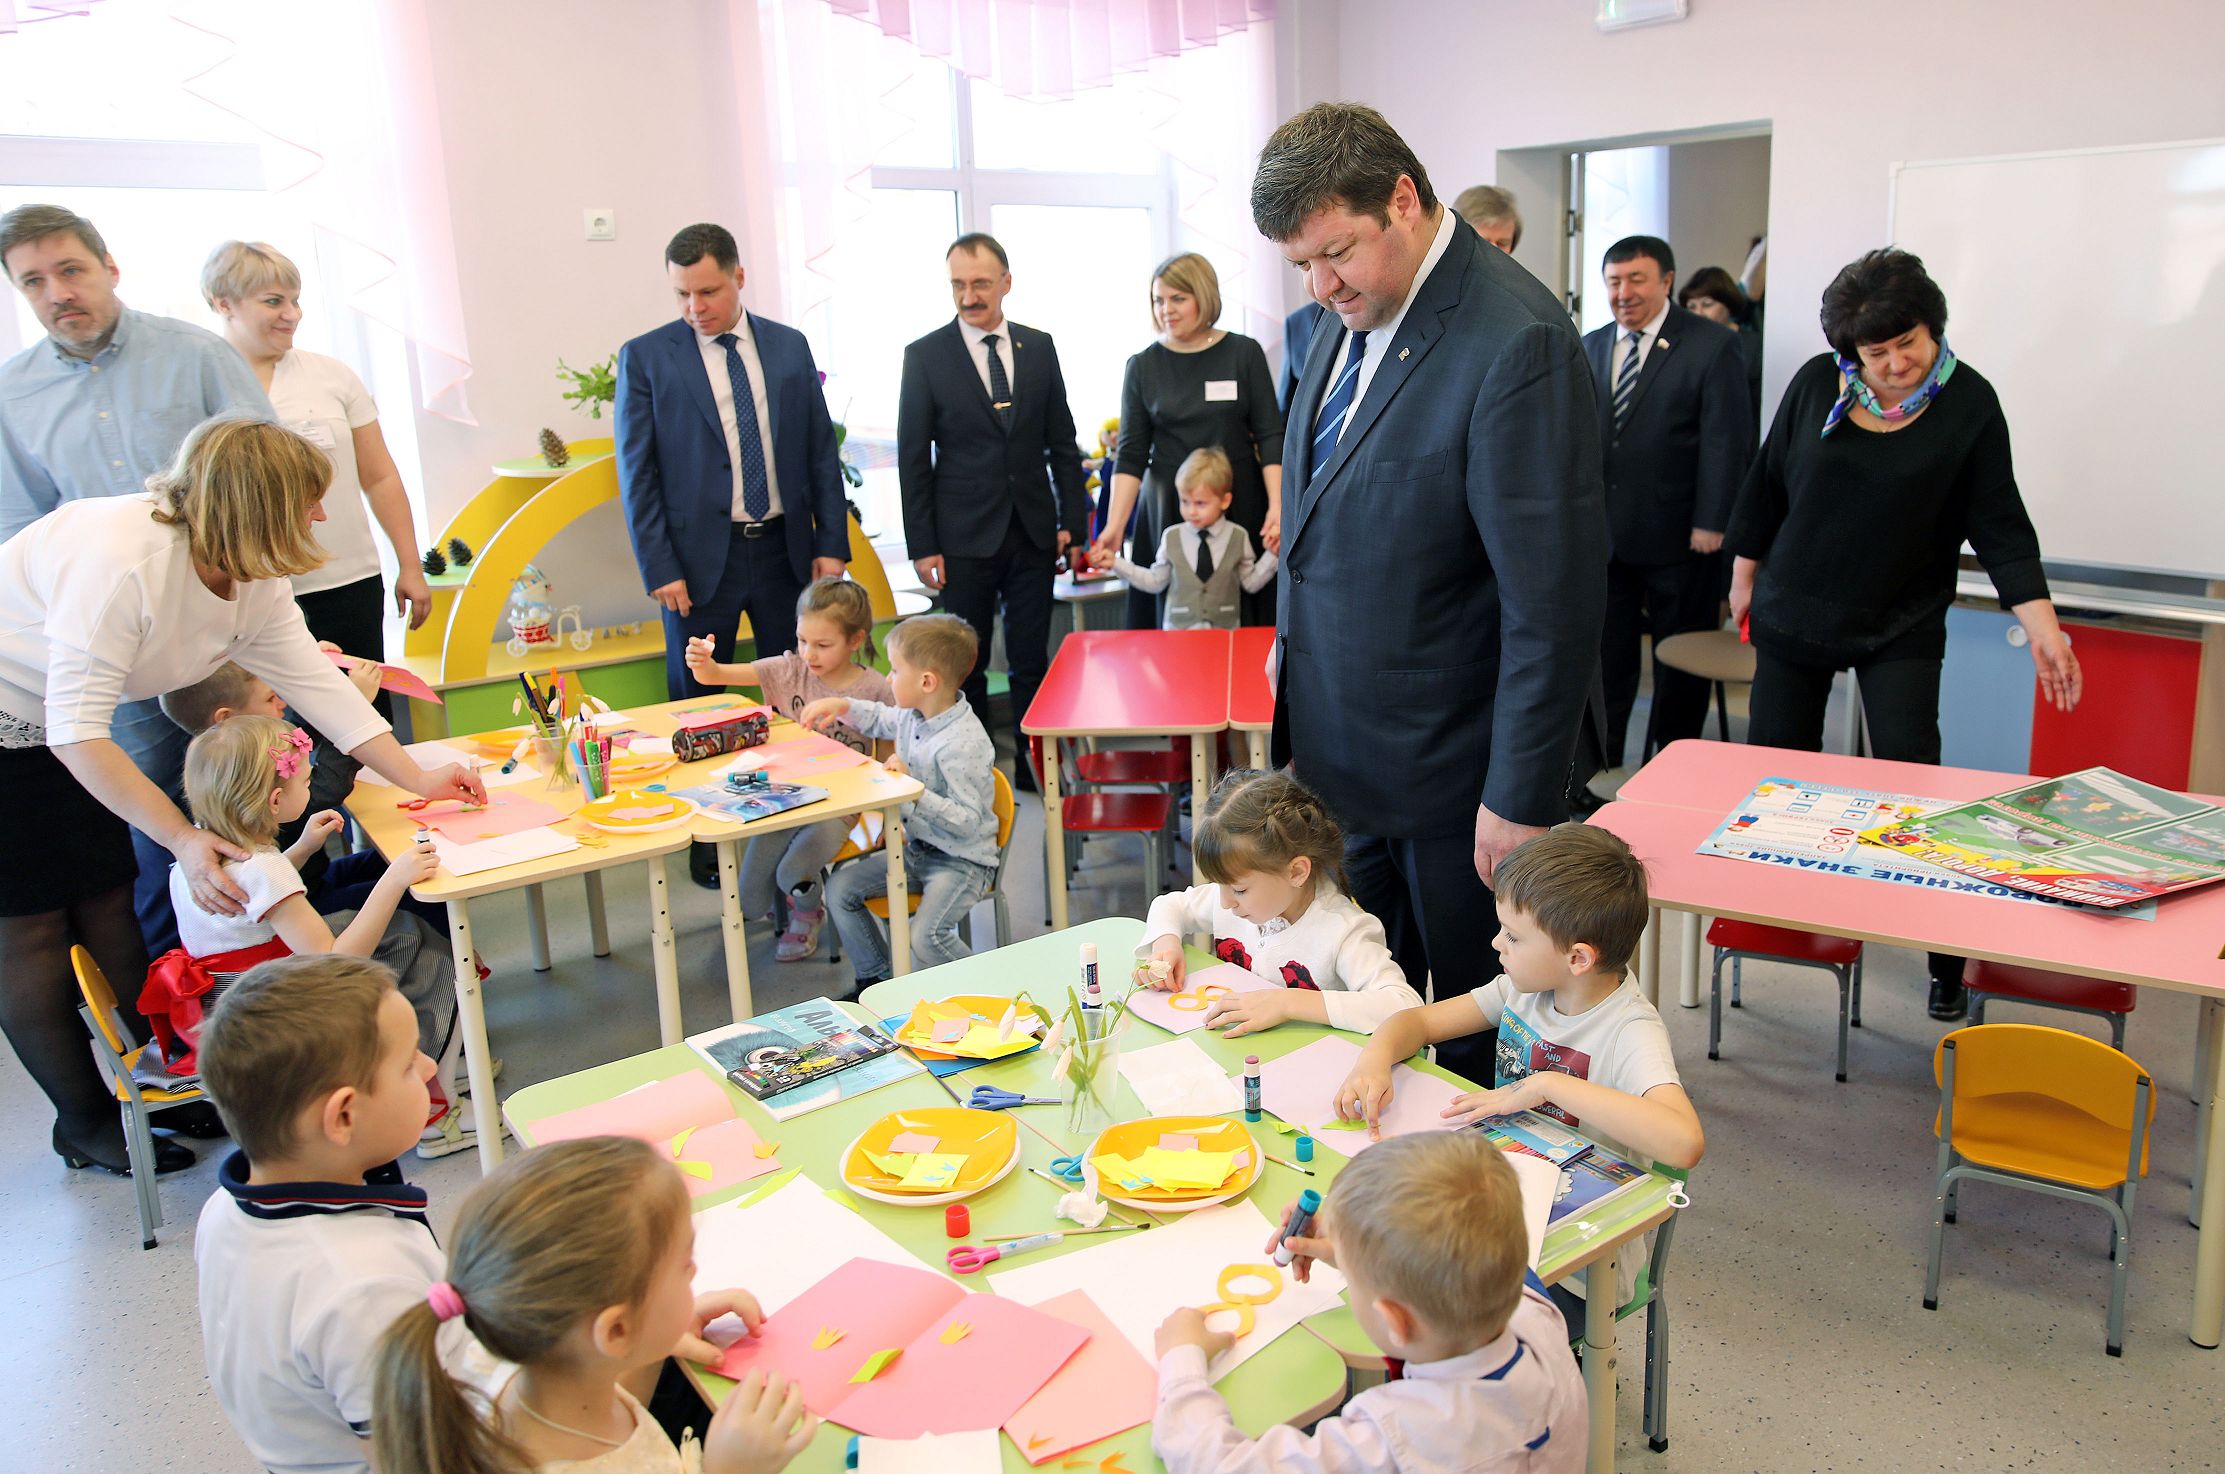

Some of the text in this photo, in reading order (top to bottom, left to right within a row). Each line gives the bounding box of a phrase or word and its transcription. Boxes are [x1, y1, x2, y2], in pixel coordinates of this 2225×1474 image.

[1748, 851, 2084, 909] ДОРОЖНЫЕ ЗНАКИ
[1912, 849, 2126, 906] ВНИМАНИЕ, ДОРОГА!
[794, 1009, 840, 1036] Аль
[1501, 1010, 1516, 1029] KING
[1513, 1024, 1525, 1035] OF
[1536, 1040, 1556, 1054] FAST
[1544, 1052, 1562, 1063] AND
[1537, 1105, 1566, 1120] OWERFUL
